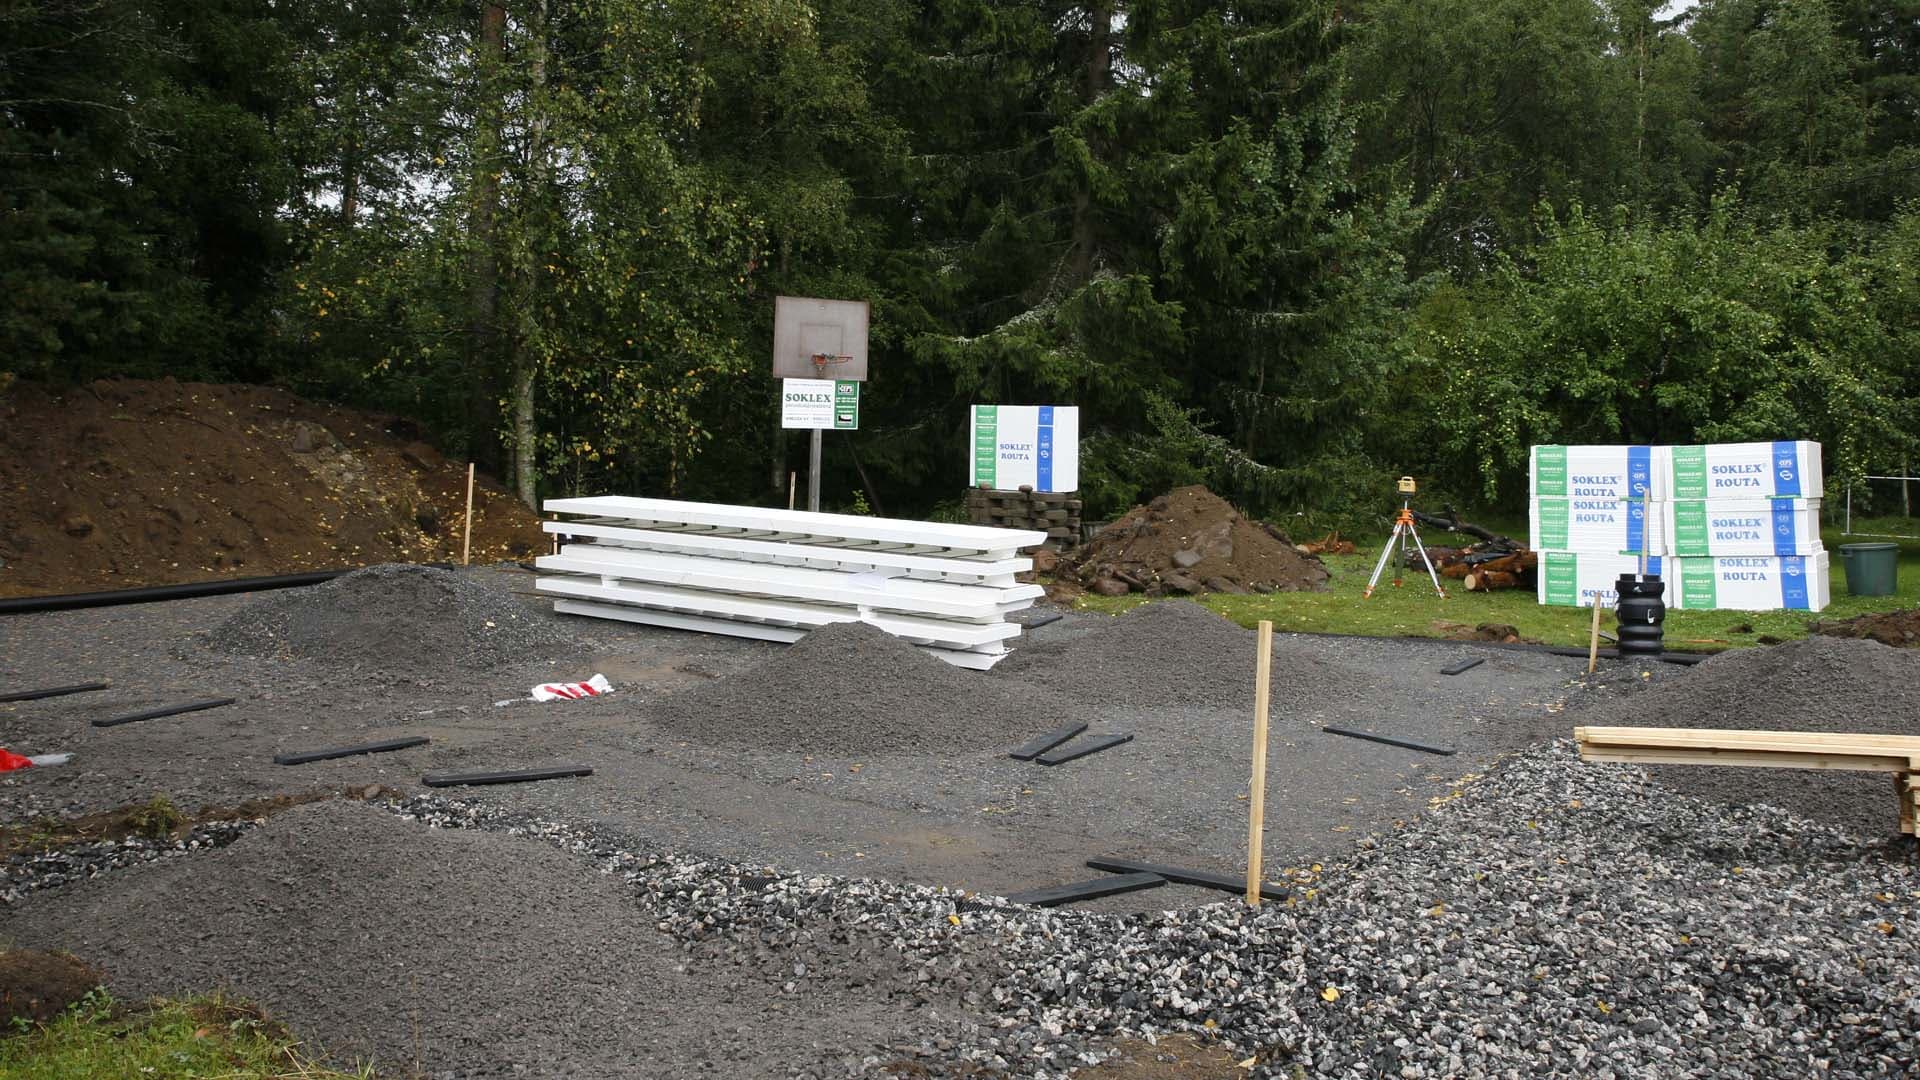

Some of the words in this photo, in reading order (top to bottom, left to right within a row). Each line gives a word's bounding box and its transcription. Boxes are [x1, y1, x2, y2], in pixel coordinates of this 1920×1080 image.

[785, 393, 831, 402] SOKLEX
[1001, 453, 1029, 461] ROUTA
[1711, 464, 1762, 474] SOKLEX
[1572, 476, 1618, 485] SOKLEX
[1715, 478, 1760, 487] ROUTA
[1574, 488, 1616, 497] ROUTA
[1573, 501, 1617, 510] SOKLEX
[1575, 514, 1614, 523] ROUTA
[1712, 518, 1761, 528] SOKLEX
[1716, 531, 1760, 540] ROUTA
[1719, 558, 1769, 568] SOKLEX
[1723, 572, 1767, 581] ROUTA
